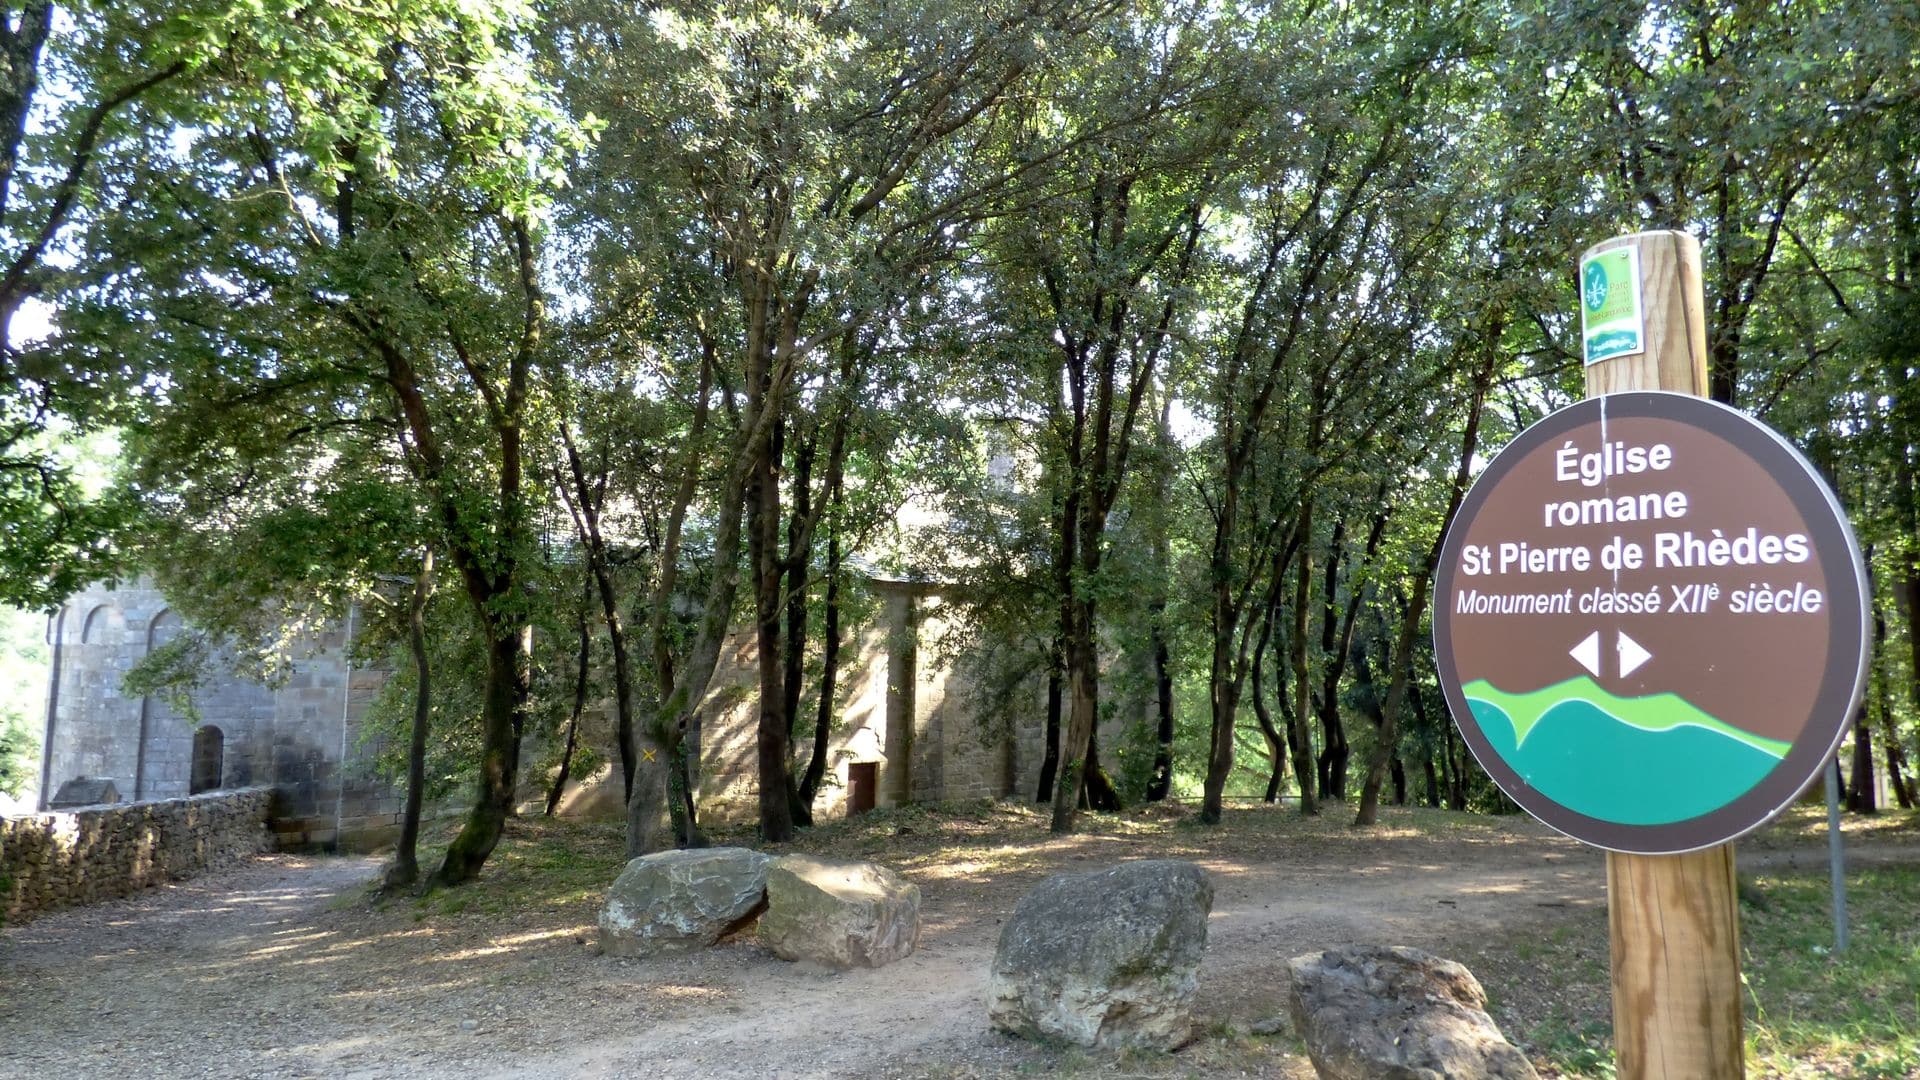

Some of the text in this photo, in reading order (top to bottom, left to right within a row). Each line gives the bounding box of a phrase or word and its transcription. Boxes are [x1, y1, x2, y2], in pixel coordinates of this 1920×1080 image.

[1556, 440, 1672, 487] Église
[1544, 490, 1688, 528] romane
[1462, 527, 1810, 576] St Pierre de Rhèdes
[1456, 588, 1573, 614] Monument
[1578, 585, 1662, 614] classé
[1728, 582, 1824, 614] siècle
